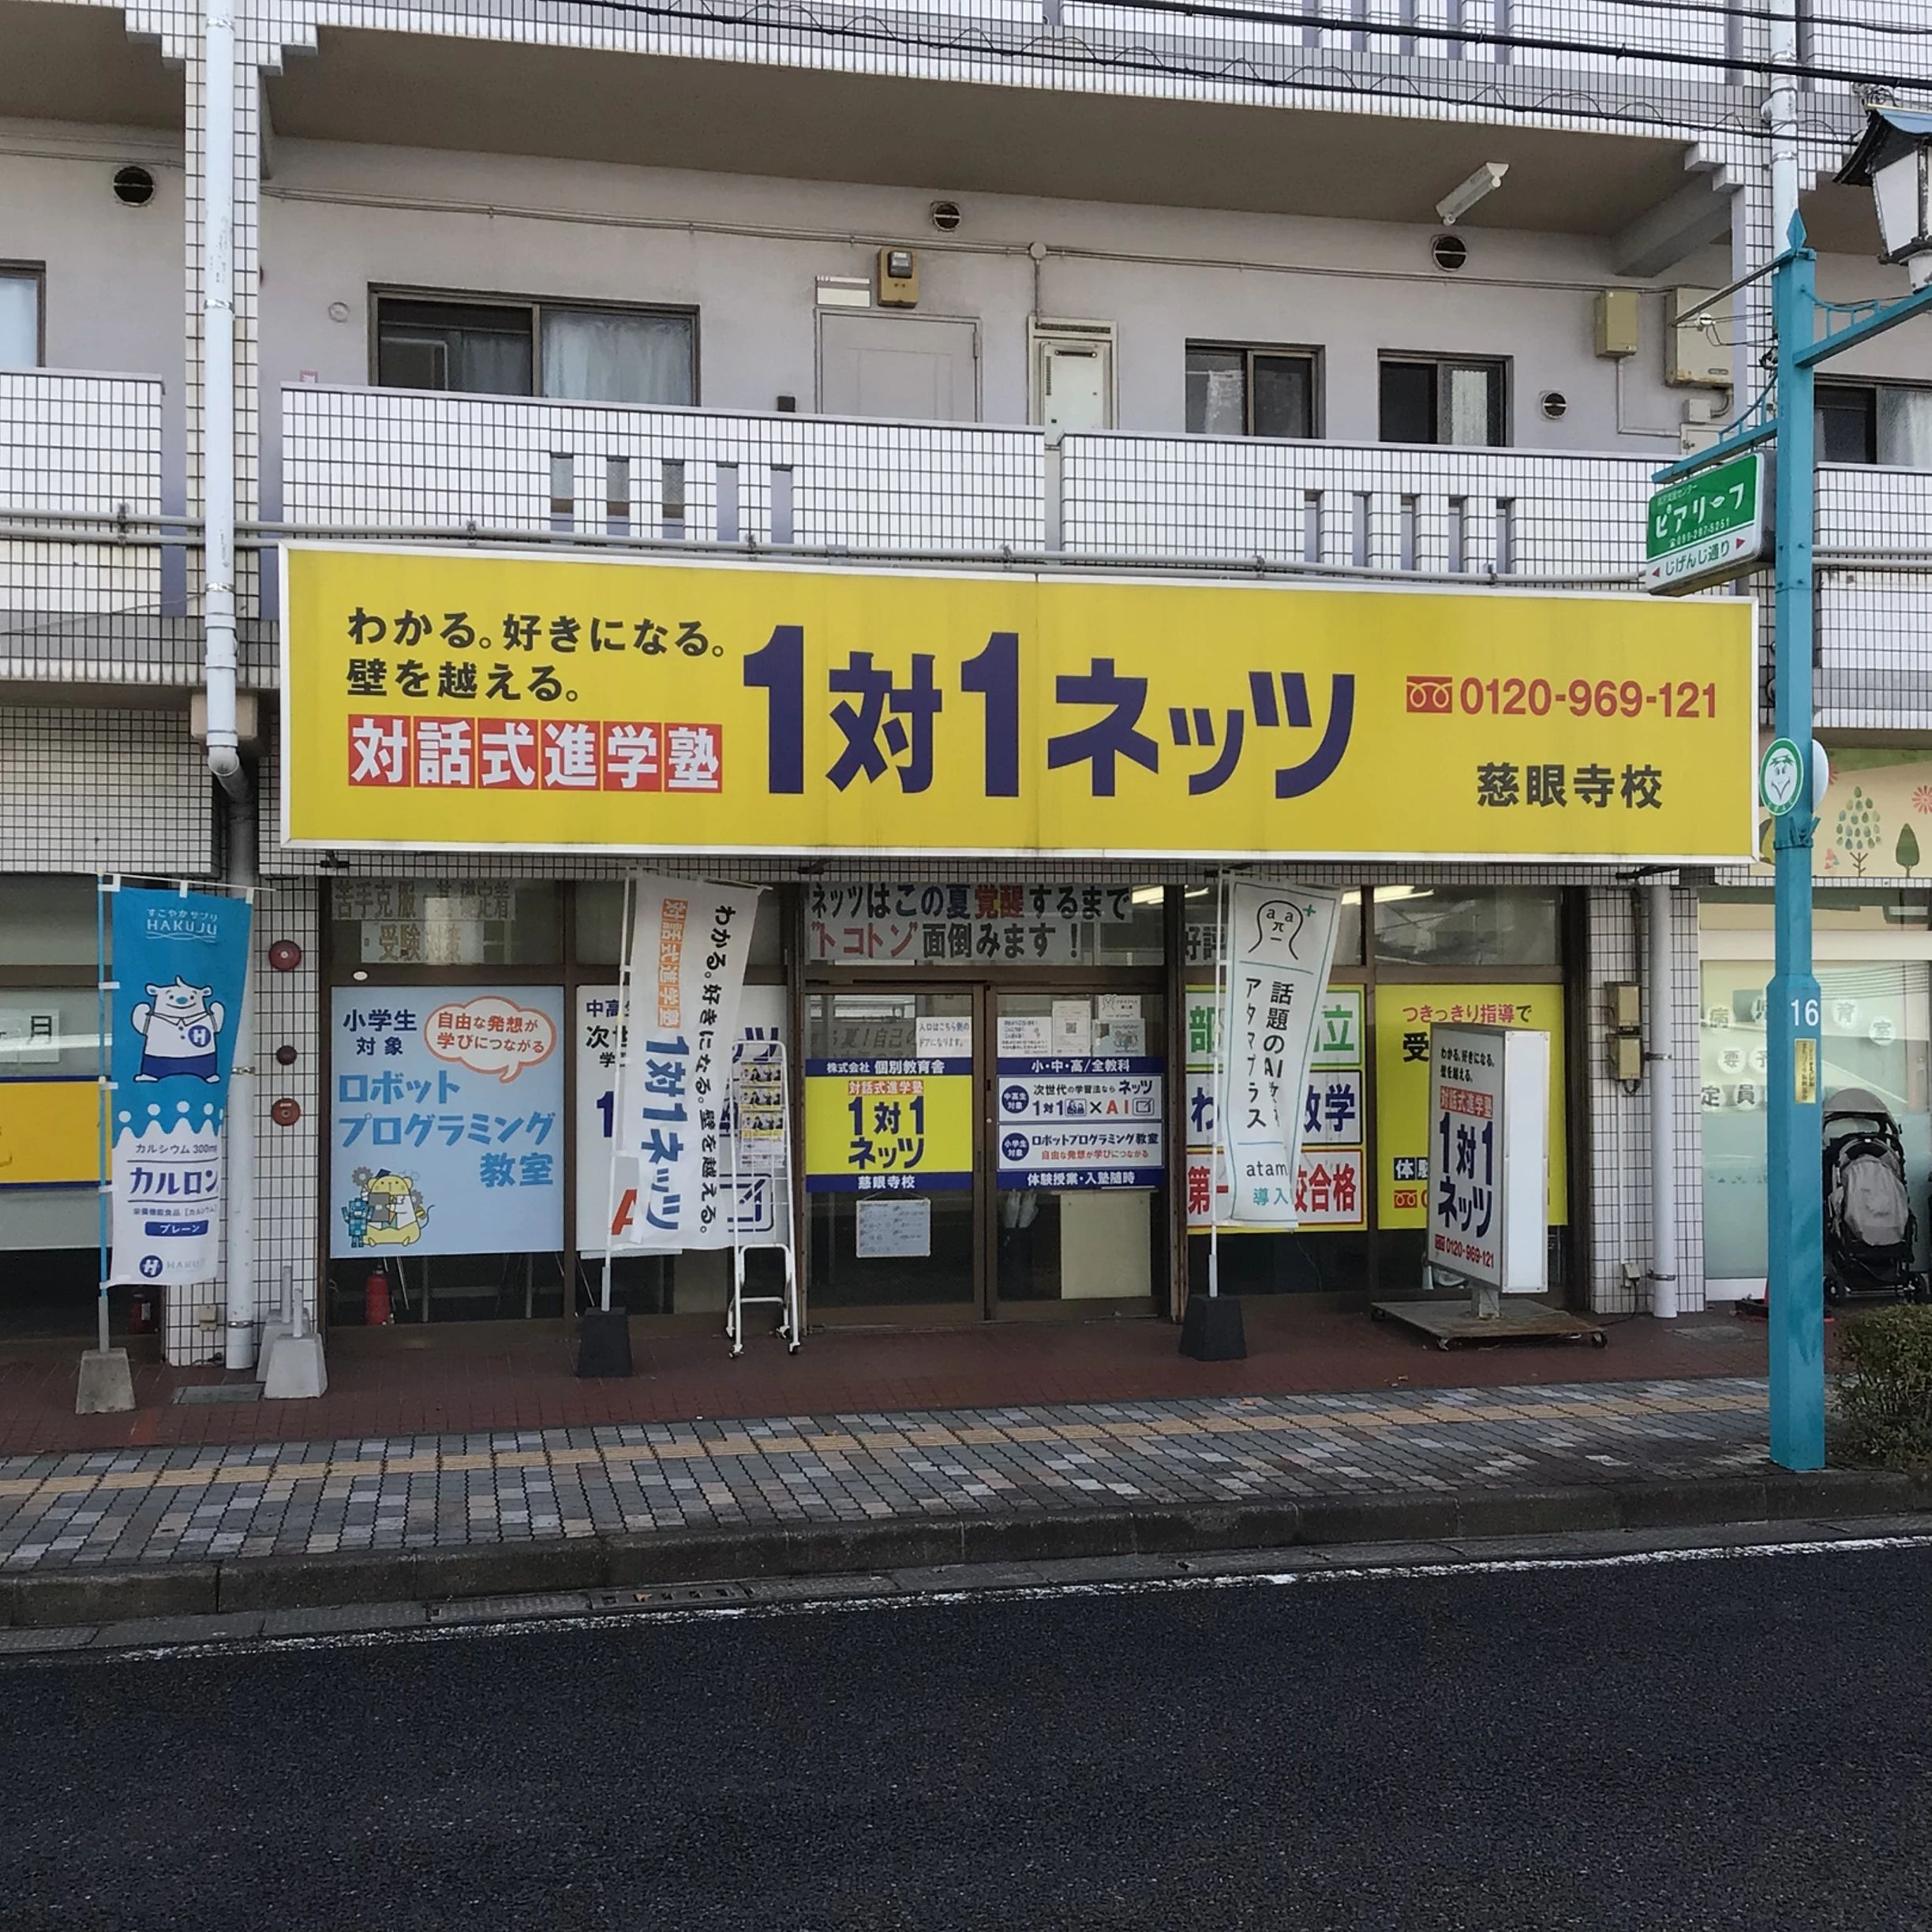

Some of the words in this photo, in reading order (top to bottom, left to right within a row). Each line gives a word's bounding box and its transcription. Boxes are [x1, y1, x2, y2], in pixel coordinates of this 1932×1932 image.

[1665, 540, 1729, 576] じげんじ通り
[347, 607, 724, 658] わかる。好きになる。
[346, 657, 579, 702] 壁を越える。
[743, 623, 1355, 799] 1対1ネッツ
[1460, 676, 1716, 718] 0120-969-121
[350, 717, 721, 789] 対話式進学塾
[1477, 762, 1663, 809] 慈眼寺校
[148, 919, 217, 935] HAKUJU
[343, 1009, 417, 1032] 小学生
[437, 1011, 538, 1032] 自由な発想が
[586, 999, 629, 1018] 中高
[1402, 1004, 1533, 1024] つきっきり指導で
[1791, 999, 1819, 1026] 16
[356, 1036, 403, 1056] 対象
[437, 1033, 545, 1054] 学びにつながる
[1263, 981, 1294, 1128] 話題のAI
[827, 1062, 870, 1073] 株式会社
[339, 1070, 460, 1105] ロボット
[849, 1080, 923, 1095] 対話式進学塾
[1118, 1080, 1152, 1095] ネッツ
[1440, 1087, 1493, 1118] 対話式進学塾
[339, 1111, 556, 1148] プログラミング
[848, 1095, 923, 1135] 1対1
[848, 1137, 924, 1170] ネッツ
[1440, 1111, 1493, 1185] 1対1
[129, 1167, 219, 1195] カルロン
[480, 1152, 554, 1188] 教室
[858, 1175, 915, 1189] 慈眼寺校
[1438, 1174, 1492, 1238] ネッツ
[160, 1224, 200, 1234] プレーン
[1446, 1236, 1494, 1268] 0120-969-121
